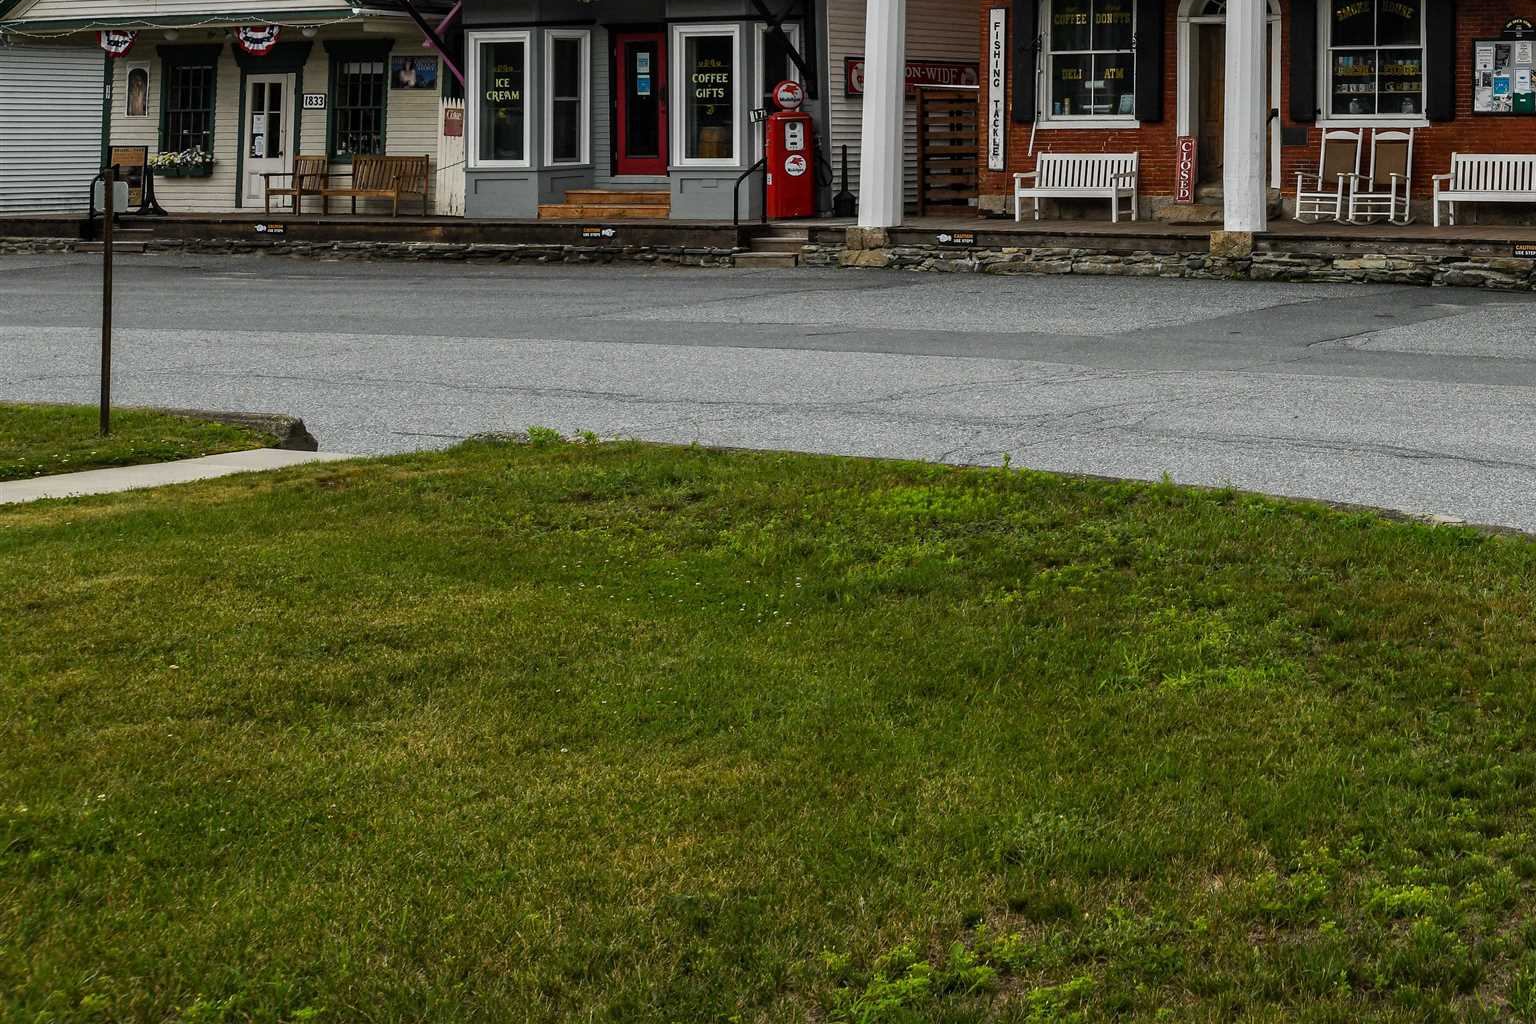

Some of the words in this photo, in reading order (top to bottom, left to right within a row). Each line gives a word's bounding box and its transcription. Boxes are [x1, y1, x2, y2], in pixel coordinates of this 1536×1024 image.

[1055, 14, 1088, 25] COFFEE
[993, 22, 1001, 88] FISHING
[692, 73, 729, 83] COFFEE
[1062, 68, 1082, 79] DELI
[1104, 68, 1125, 79] ATM
[495, 78, 510, 87] ICE
[486, 91, 520, 102] CREAM
[695, 88, 725, 98] GIFTS
[304, 96, 324, 106] 1833
[992, 100, 1001, 156] TACKLE
[1180, 142, 1191, 197] CLOSED
